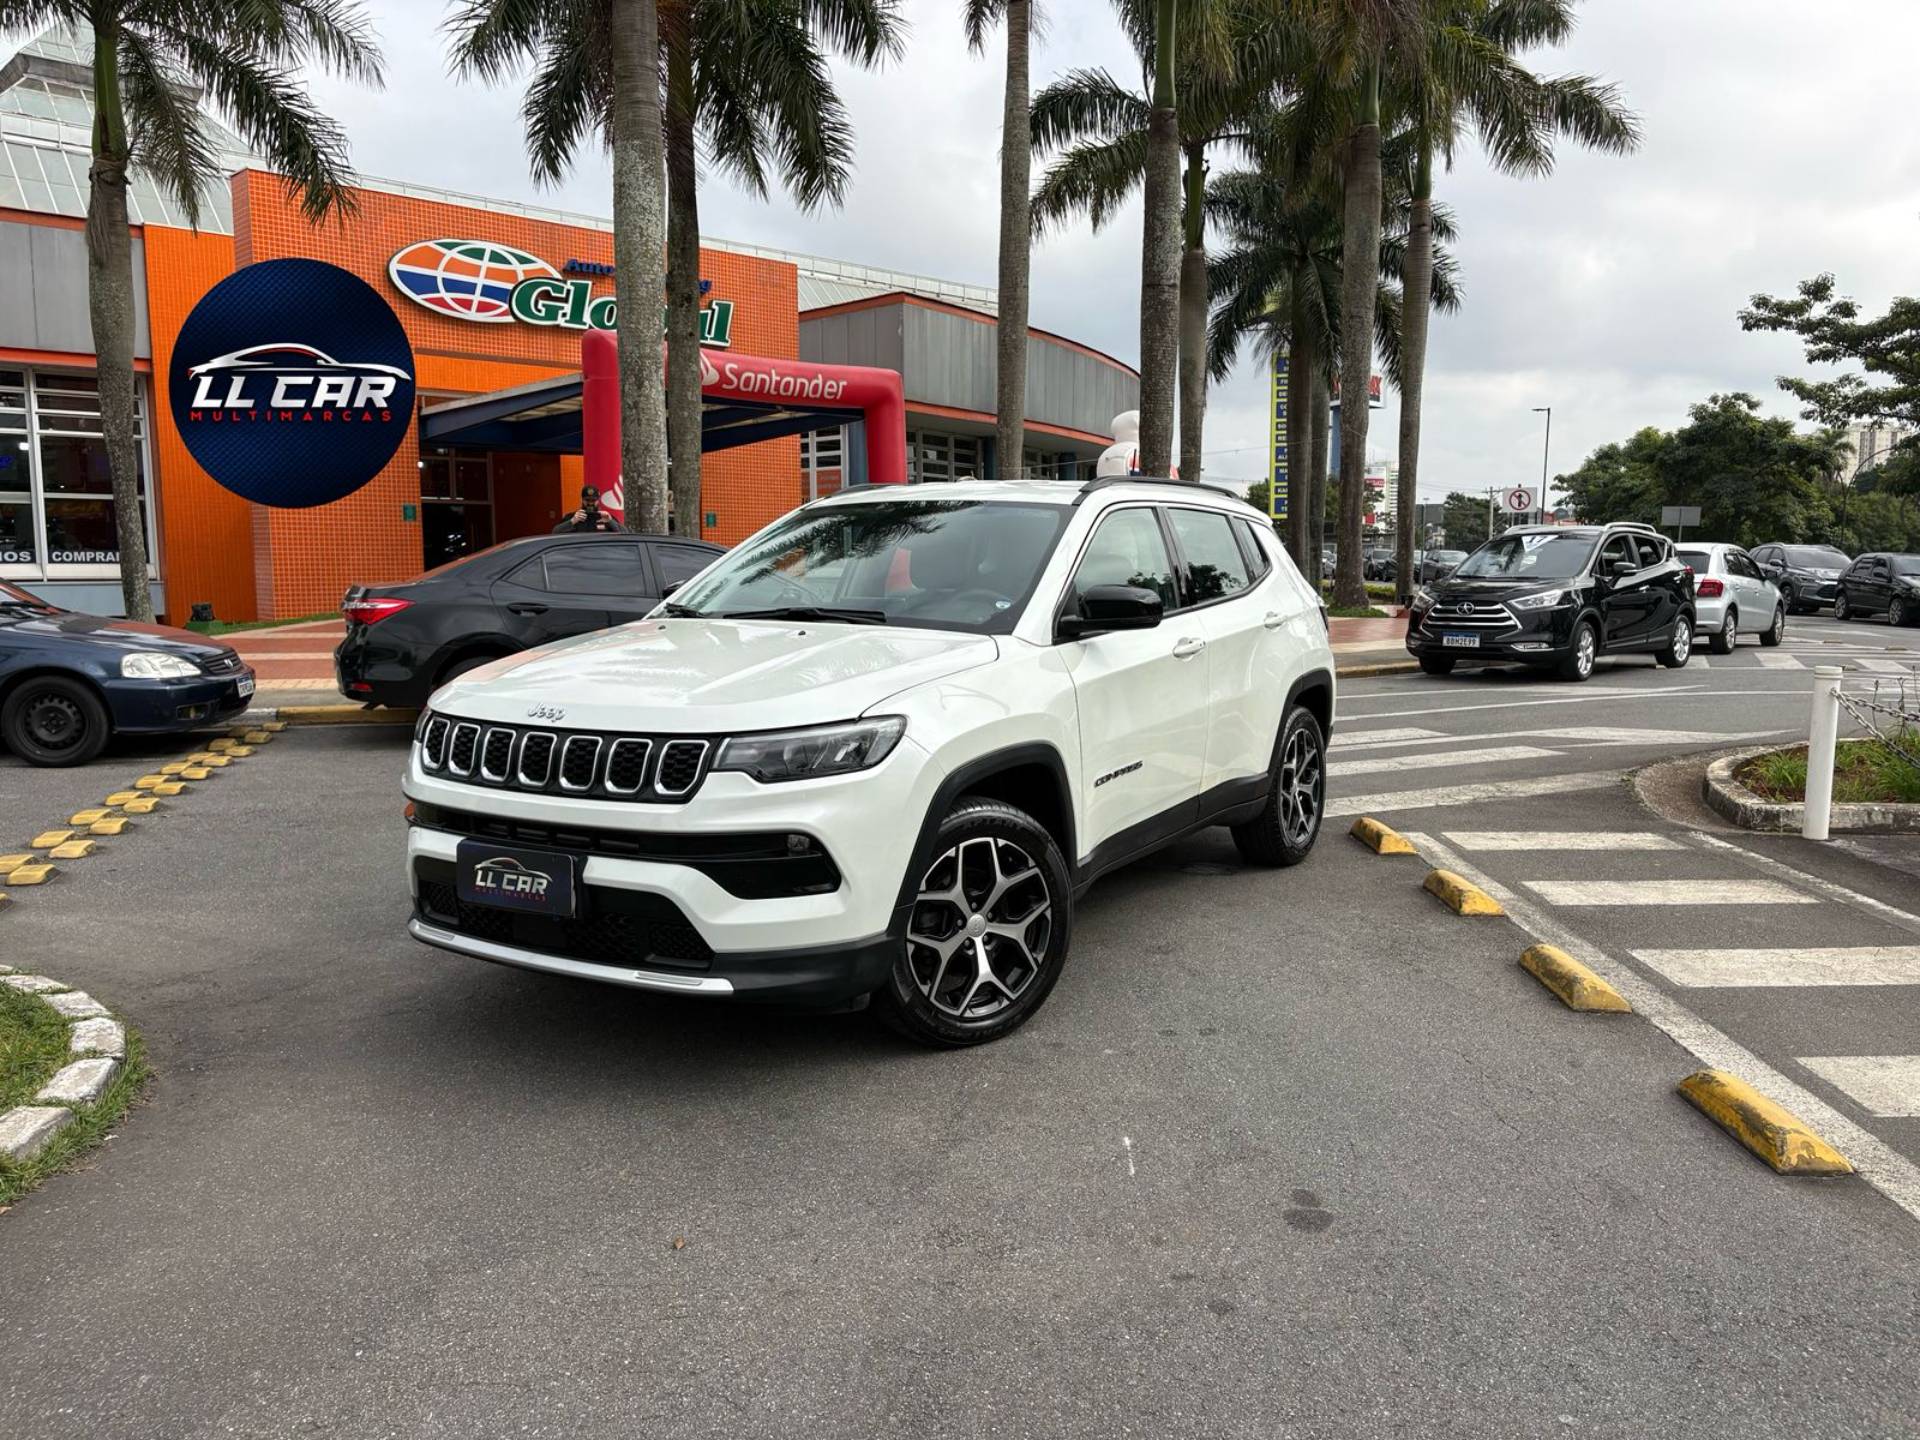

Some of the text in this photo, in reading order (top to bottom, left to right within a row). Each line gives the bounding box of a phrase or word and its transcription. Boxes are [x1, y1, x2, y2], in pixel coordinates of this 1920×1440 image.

[563, 258, 615, 276] Auto
[511, 278, 734, 346] Glol
[722, 363, 847, 399] Santander
[0, 551, 31, 562] OS
[527, 702, 566, 723] Jeep
[1094, 760, 1143, 788] COMPASS
[475, 870, 548, 894] LL CAR
